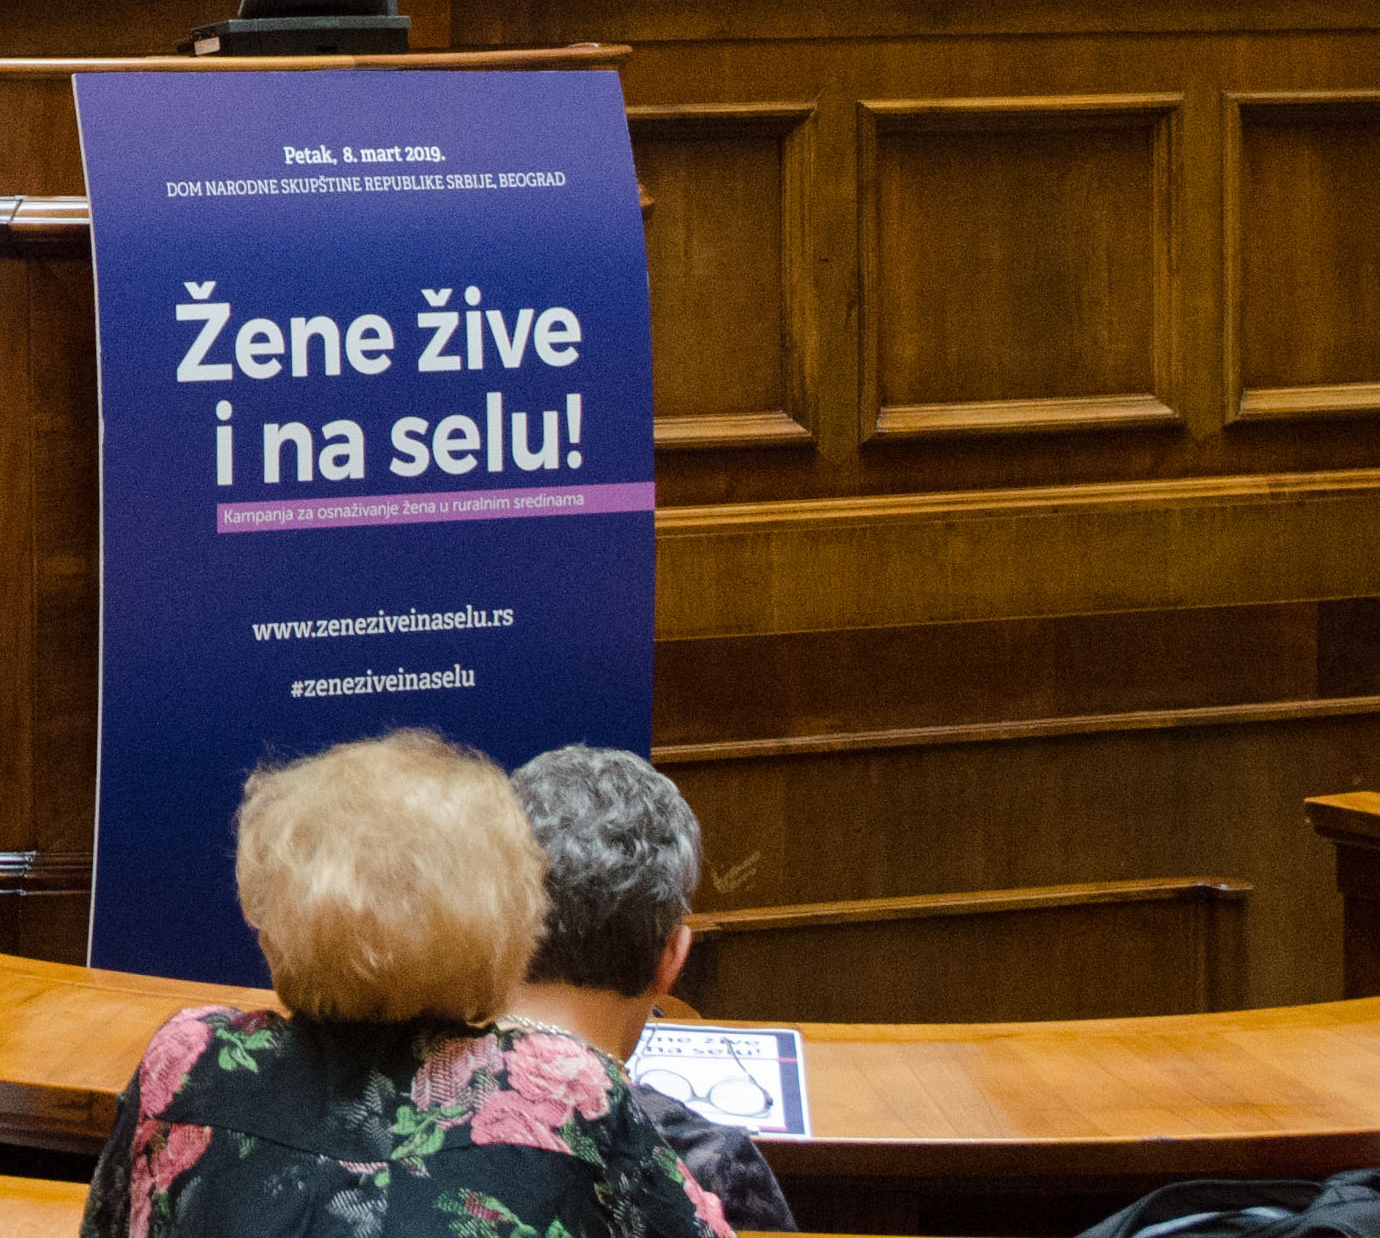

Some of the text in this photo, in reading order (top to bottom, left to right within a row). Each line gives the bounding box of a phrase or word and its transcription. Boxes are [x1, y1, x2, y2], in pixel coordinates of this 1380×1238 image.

[283, 144, 446, 166] Petak, 8. mart 2019.
[166, 170, 567, 198] DOM NARODNE SKUPŠTINE REPUBLIKE SRBIJE, BEOGRAD
[175, 280, 584, 383] Žene žive
[215, 391, 584, 487] i na selu!
[223, 493, 585, 525] Kampanja za osnaživanje žena u ruralnim sredinama
[252, 604, 514, 642] www.zeneziveinaselu.rs
[290, 664, 476, 699] #zeneziveinaselu
